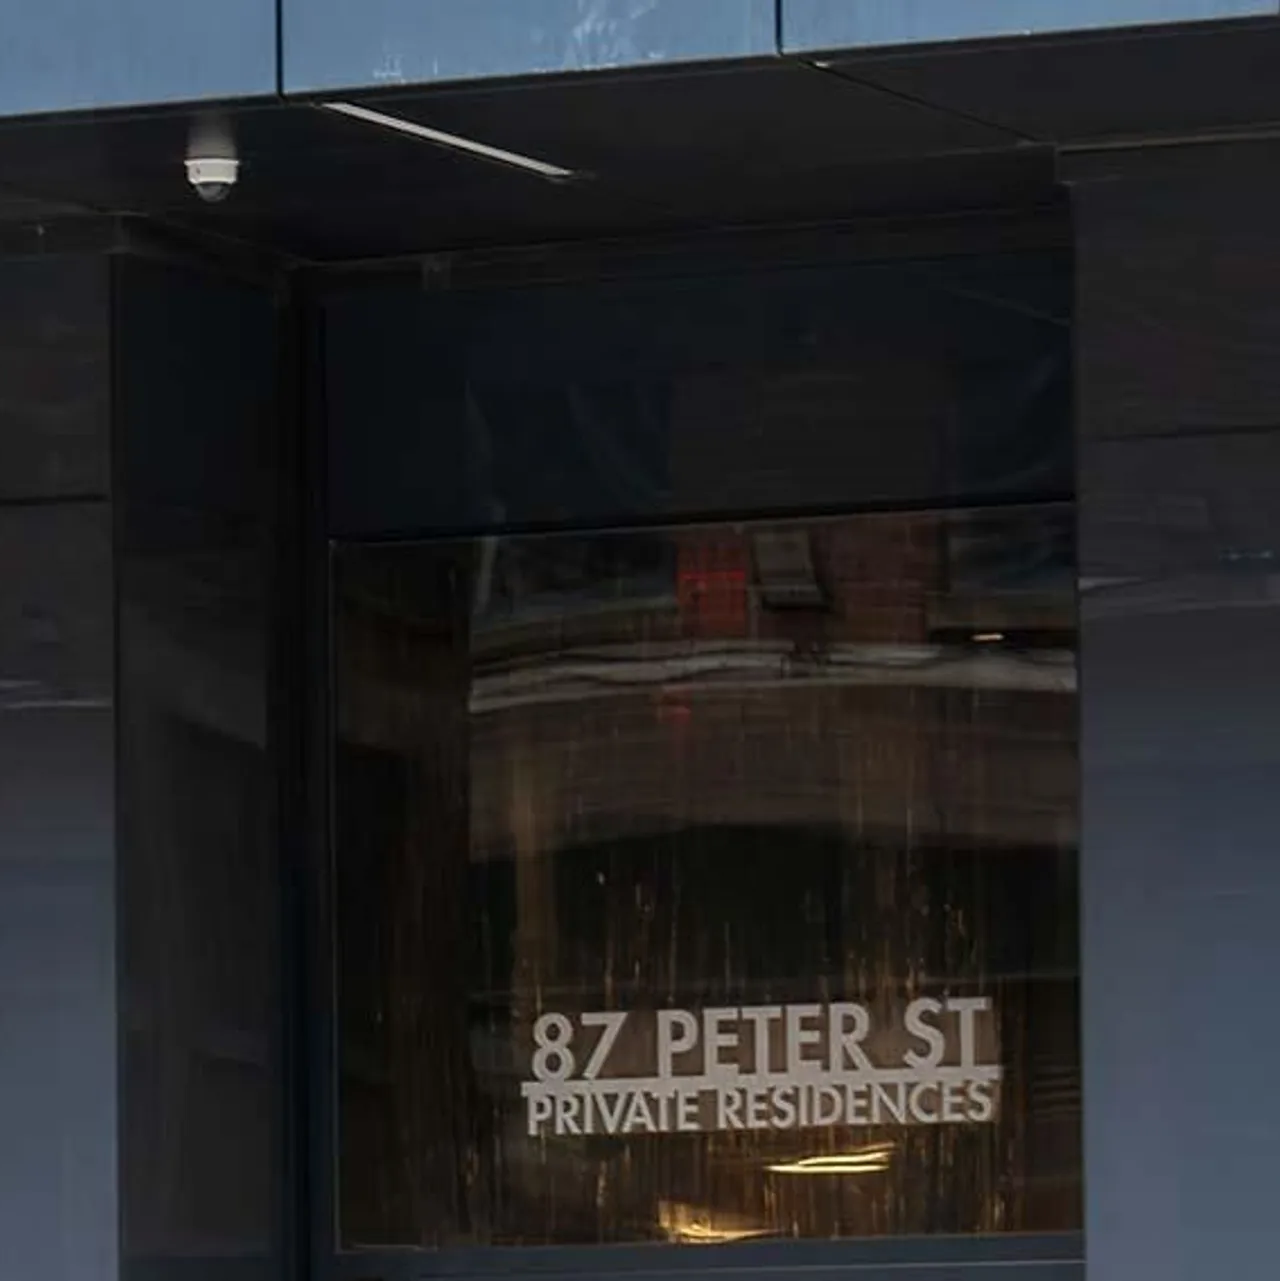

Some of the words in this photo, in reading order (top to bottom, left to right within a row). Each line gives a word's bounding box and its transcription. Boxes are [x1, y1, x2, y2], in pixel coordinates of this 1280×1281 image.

[531, 1013, 628, 1082] 87
[656, 1002, 873, 1078] PETER
[903, 997, 988, 1069] ST
[527, 1090, 701, 1136] PRIVATE
[718, 1080, 993, 1130] RESIDENCES
